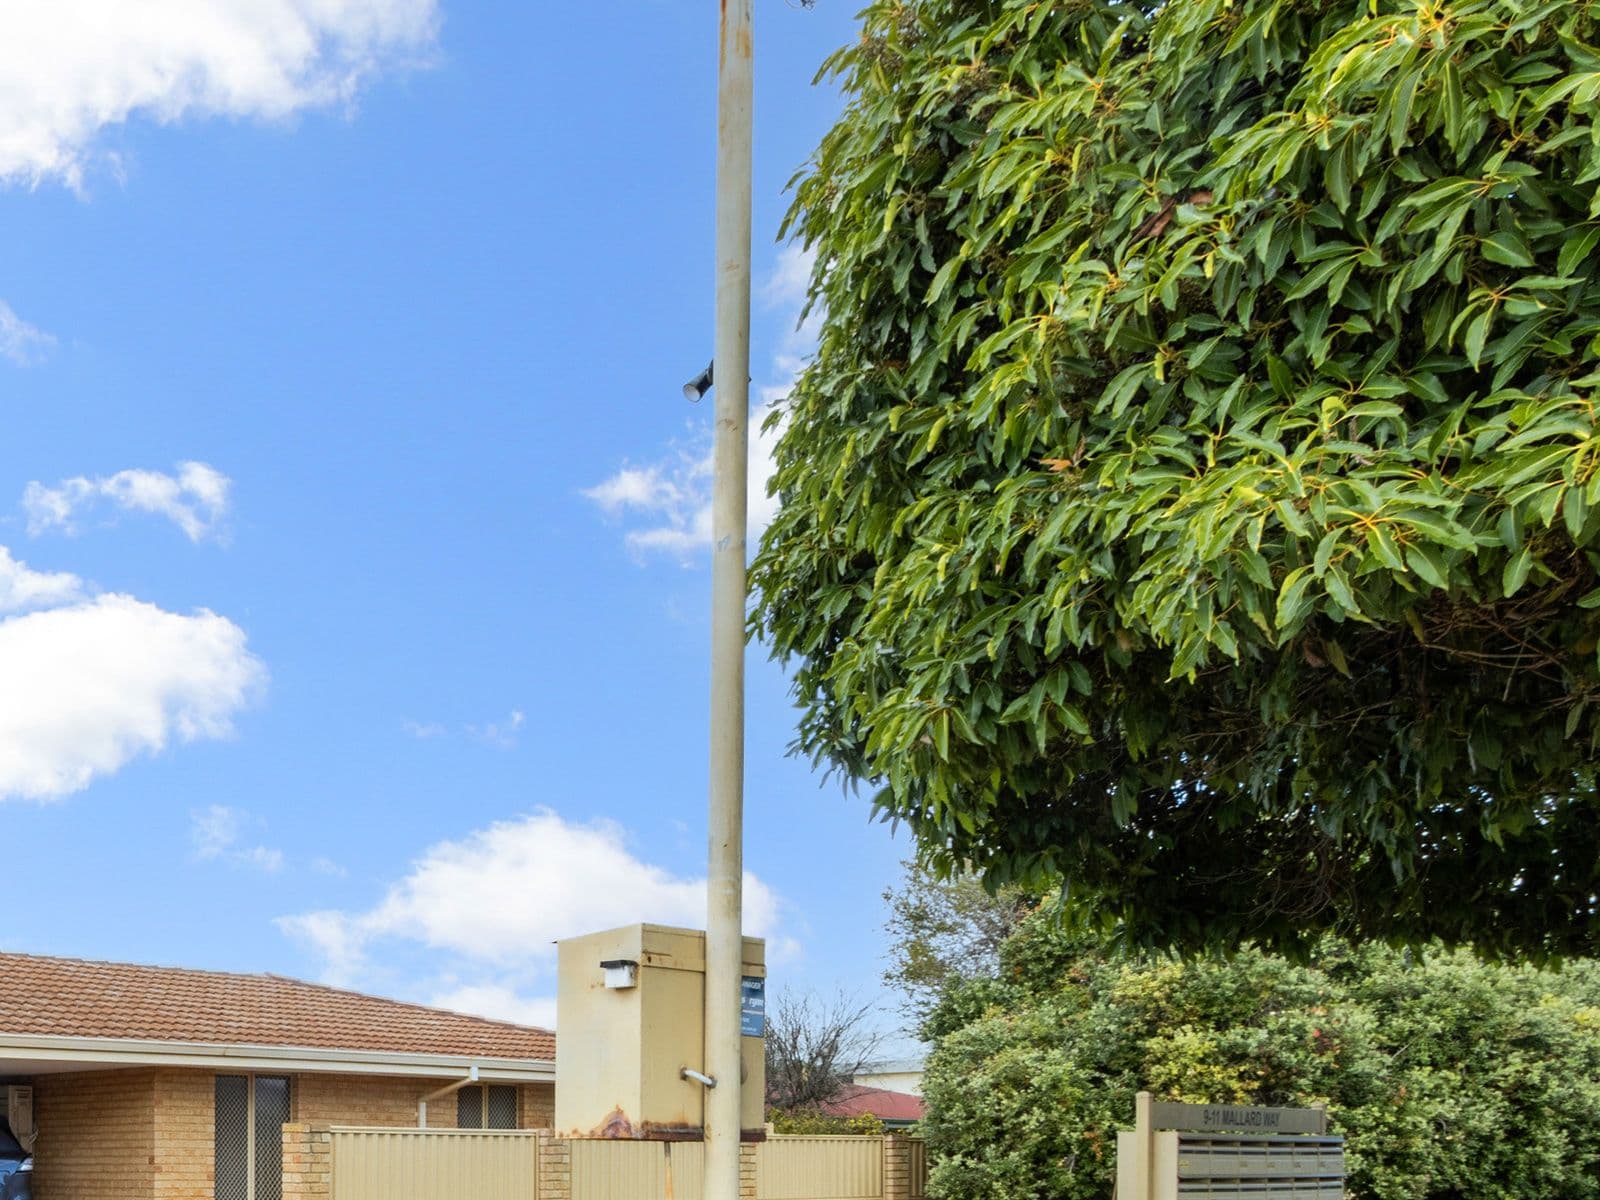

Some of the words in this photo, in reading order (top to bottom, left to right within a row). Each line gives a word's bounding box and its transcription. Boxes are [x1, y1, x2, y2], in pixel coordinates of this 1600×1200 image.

[1203, 1109, 1220, 1126] 9-11
[1222, 1110, 1262, 1127] MALLARD
[1263, 1111, 1280, 1128] WAY
